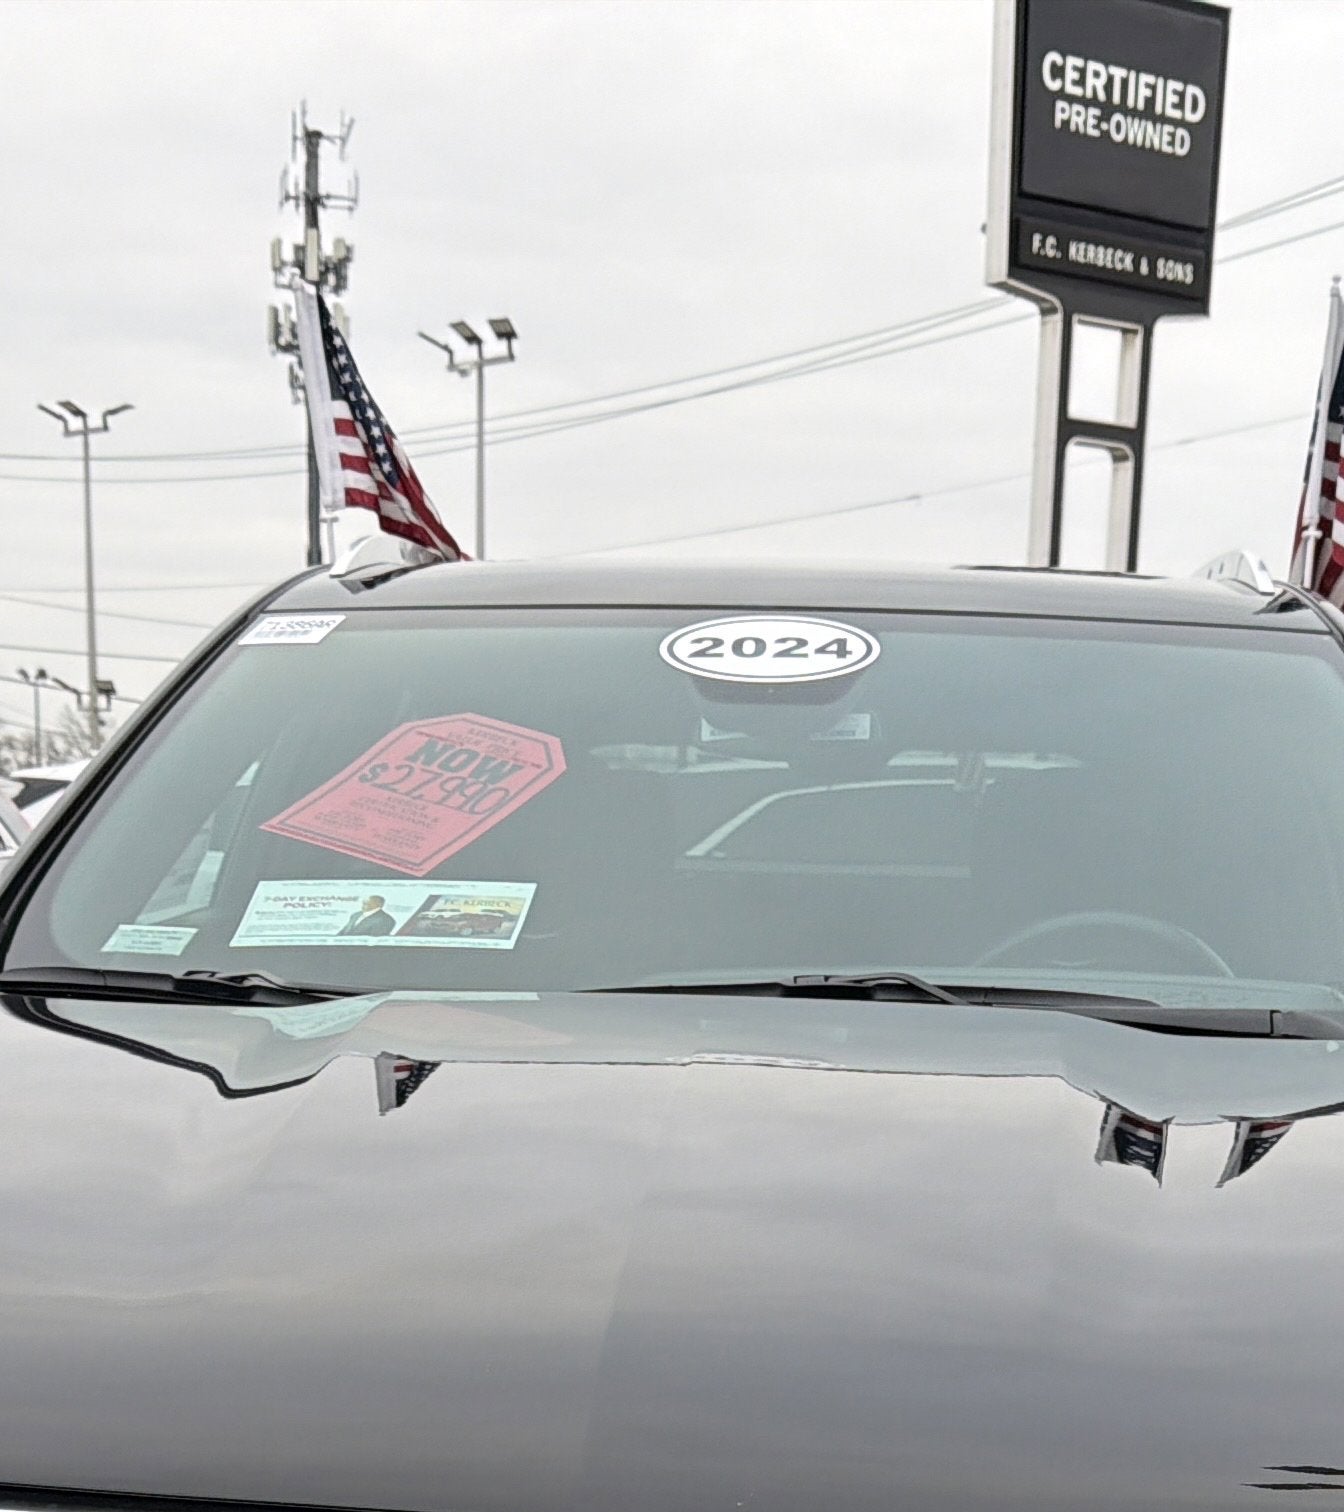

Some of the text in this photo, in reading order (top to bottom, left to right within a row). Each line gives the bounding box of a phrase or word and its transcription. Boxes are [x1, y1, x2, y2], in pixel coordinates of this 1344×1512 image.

[1042, 50, 1207, 123] CERTIFIED
[1054, 99, 1192, 157] PRE-OWNED
[1031, 232, 1195, 286] F.C. KERBECK & SONS
[687, 636, 853, 659] 2024
[406, 737, 526, 786] NOW
